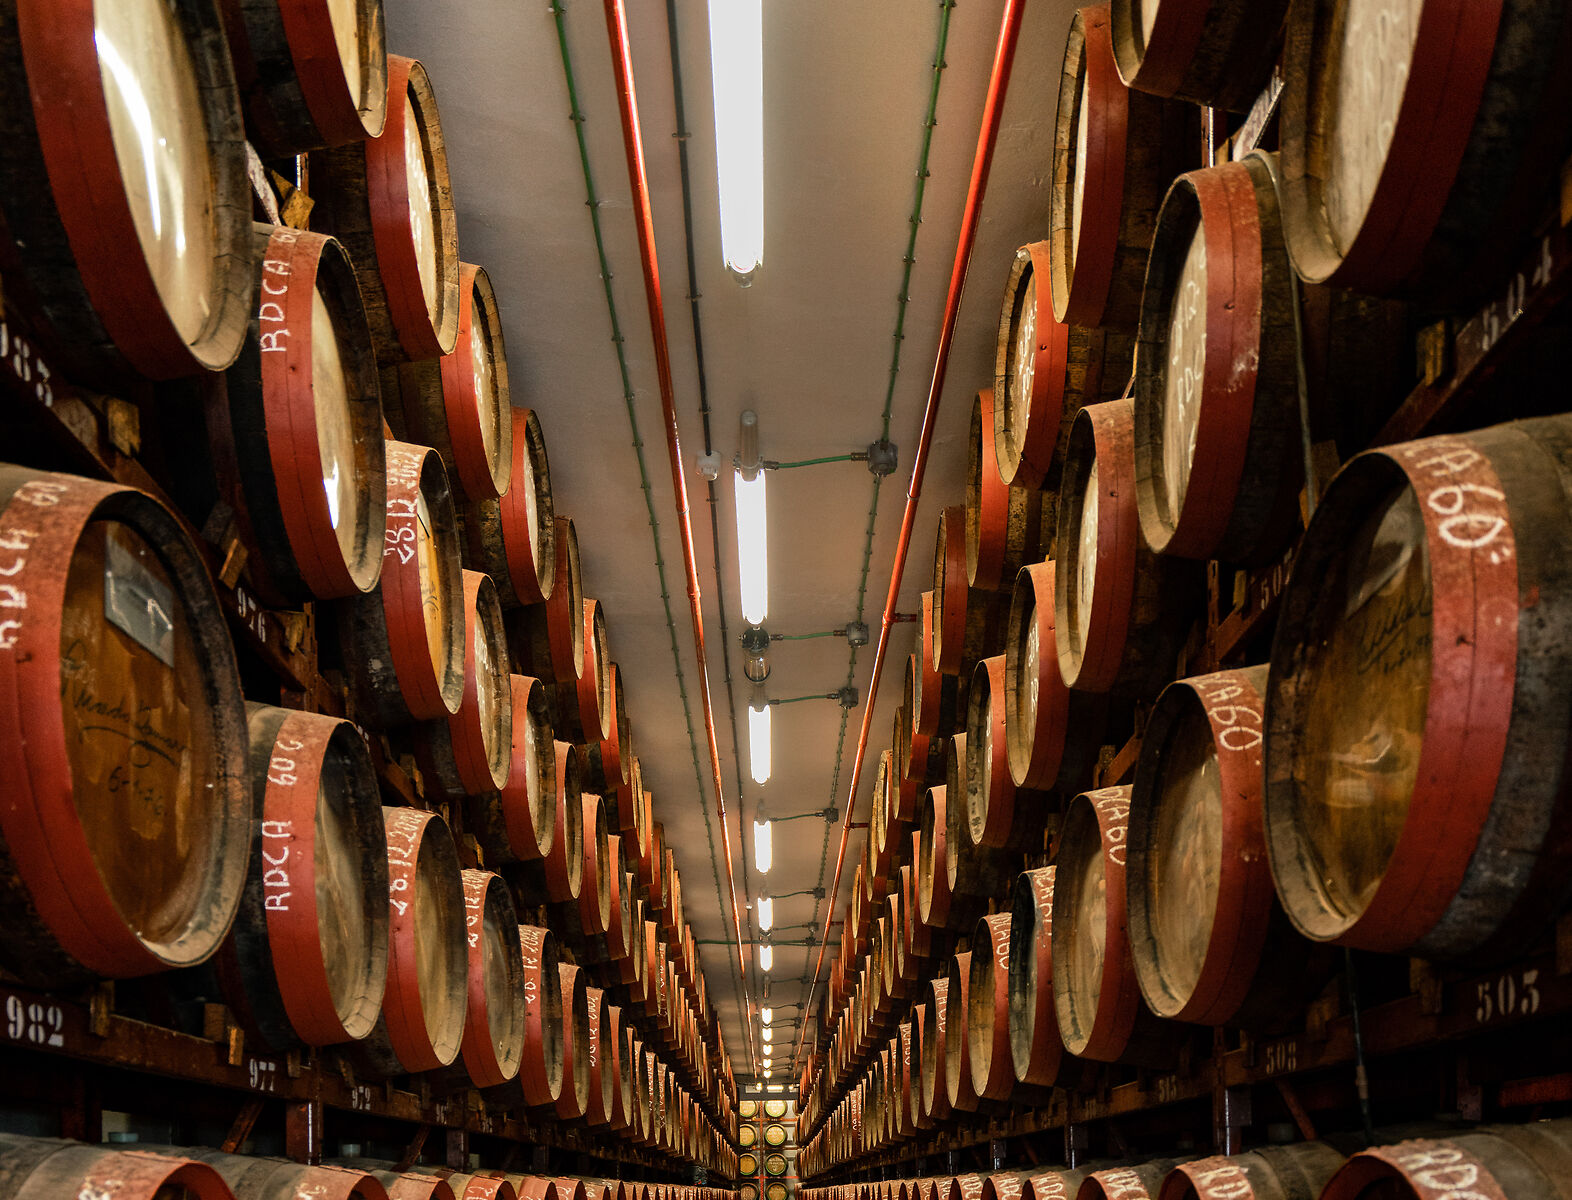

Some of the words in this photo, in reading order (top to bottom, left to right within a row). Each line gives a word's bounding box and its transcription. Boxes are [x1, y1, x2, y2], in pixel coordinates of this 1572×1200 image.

[259, 259, 292, 352] RDCA
[261, 820, 293, 912] RDCA
[6, 995, 64, 1047] 982
[1476, 968, 1541, 1025] 503
[249, 1057, 277, 1091] 977
[1265, 1040, 1298, 1075] 508
